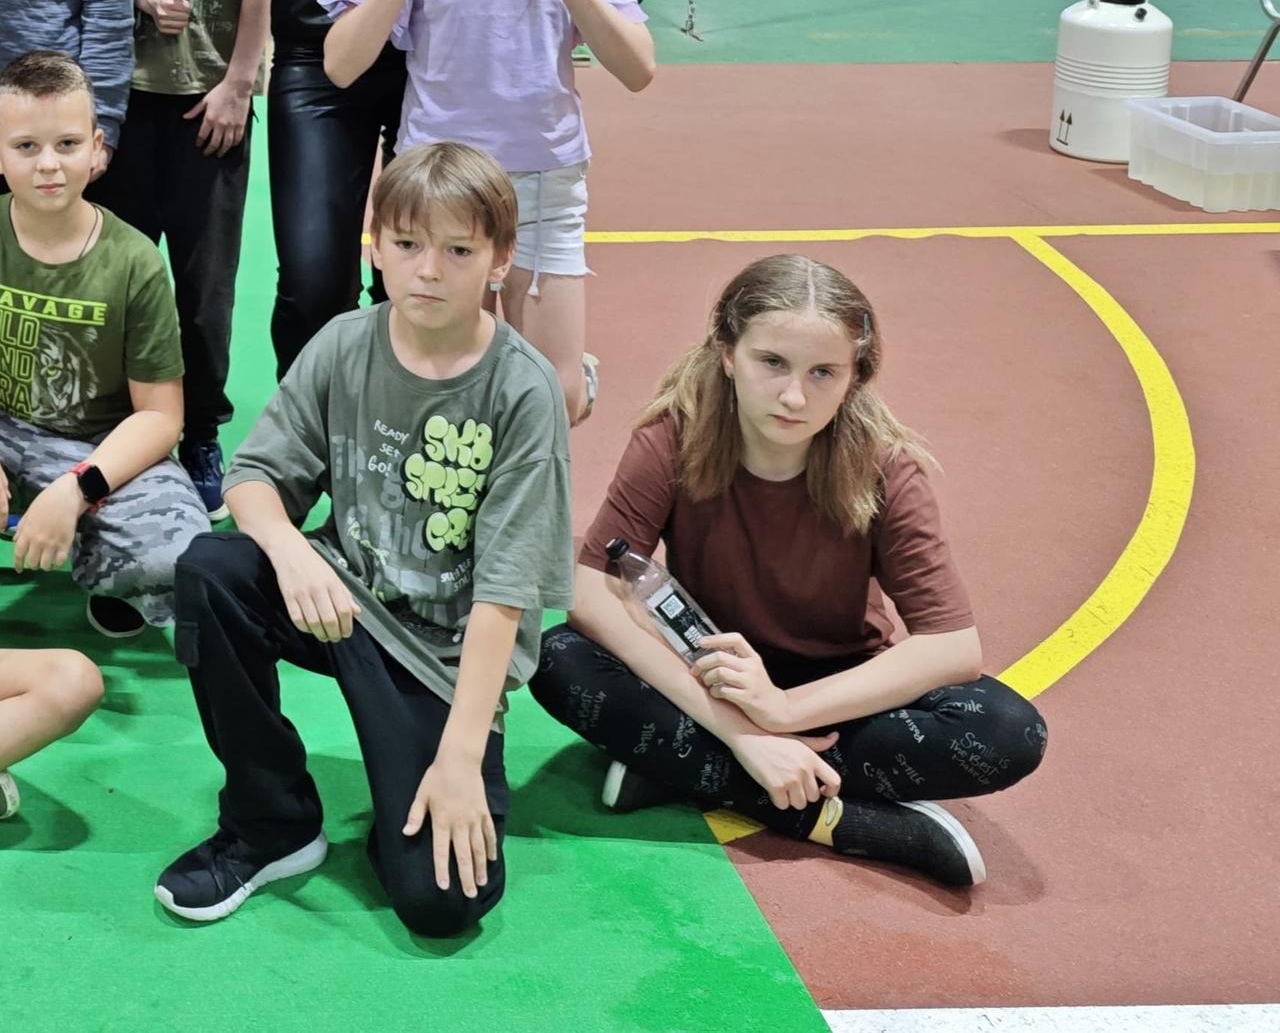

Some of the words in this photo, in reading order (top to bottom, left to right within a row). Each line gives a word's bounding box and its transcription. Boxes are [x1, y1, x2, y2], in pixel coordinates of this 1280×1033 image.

[373, 419, 411, 445] READY
[379, 443, 401, 458] SET
[367, 455, 393, 477] GO!
